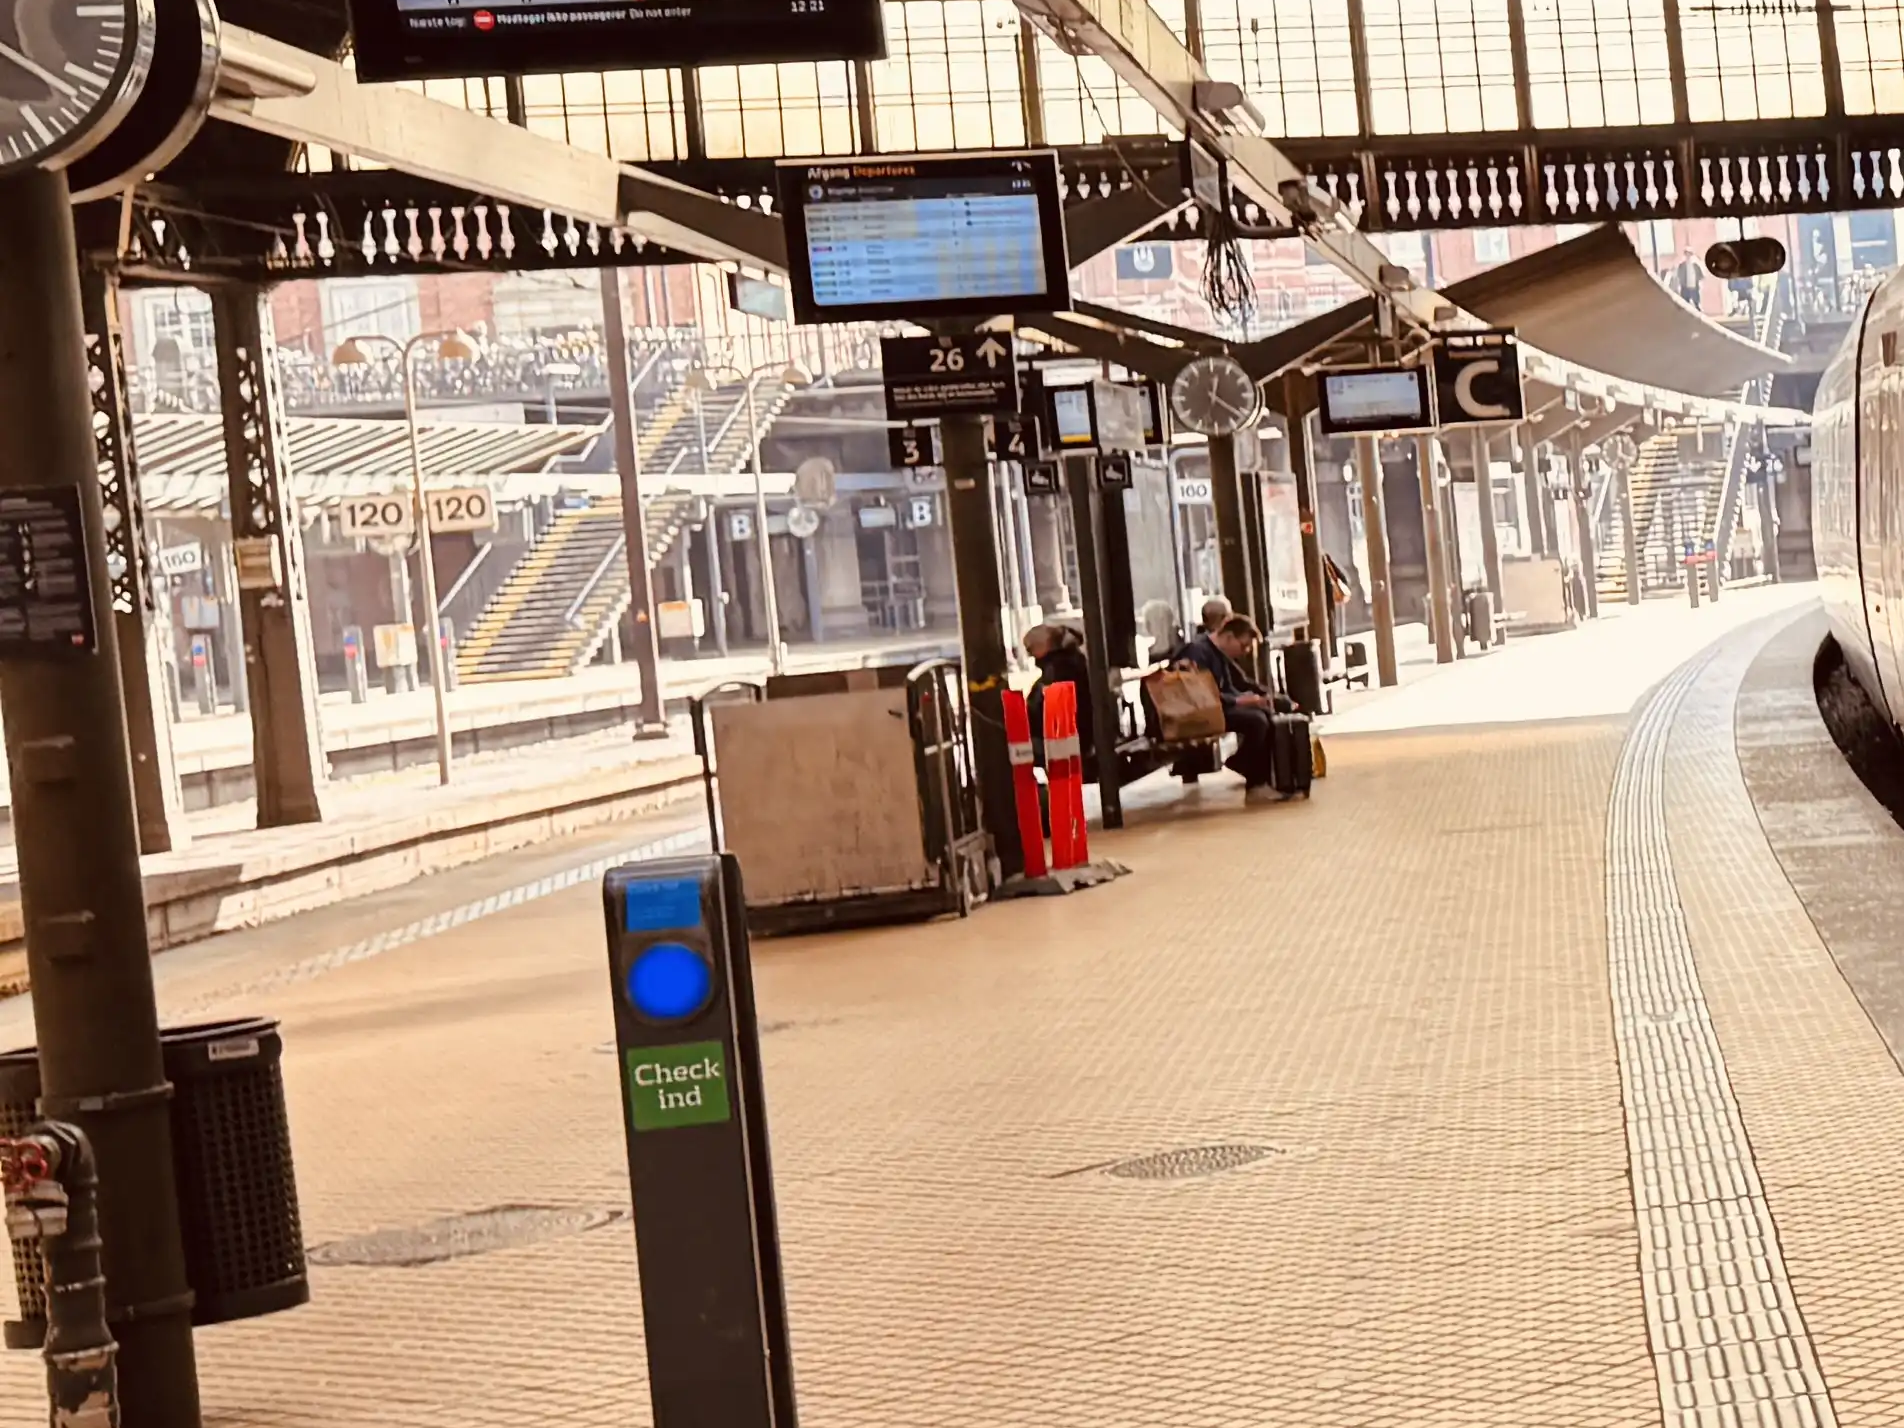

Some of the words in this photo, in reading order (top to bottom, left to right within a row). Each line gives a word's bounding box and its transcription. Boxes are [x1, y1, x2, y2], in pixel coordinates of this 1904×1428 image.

[930, 347, 965, 372] 26
[1454, 359, 1511, 418] C
[903, 440, 920, 464] 3
[1008, 433, 1025, 456] 4
[346, 502, 403, 528] 120
[433, 494, 486, 523] 120
[634, 1058, 721, 1086] Check
[658, 1085, 703, 1110] ind
